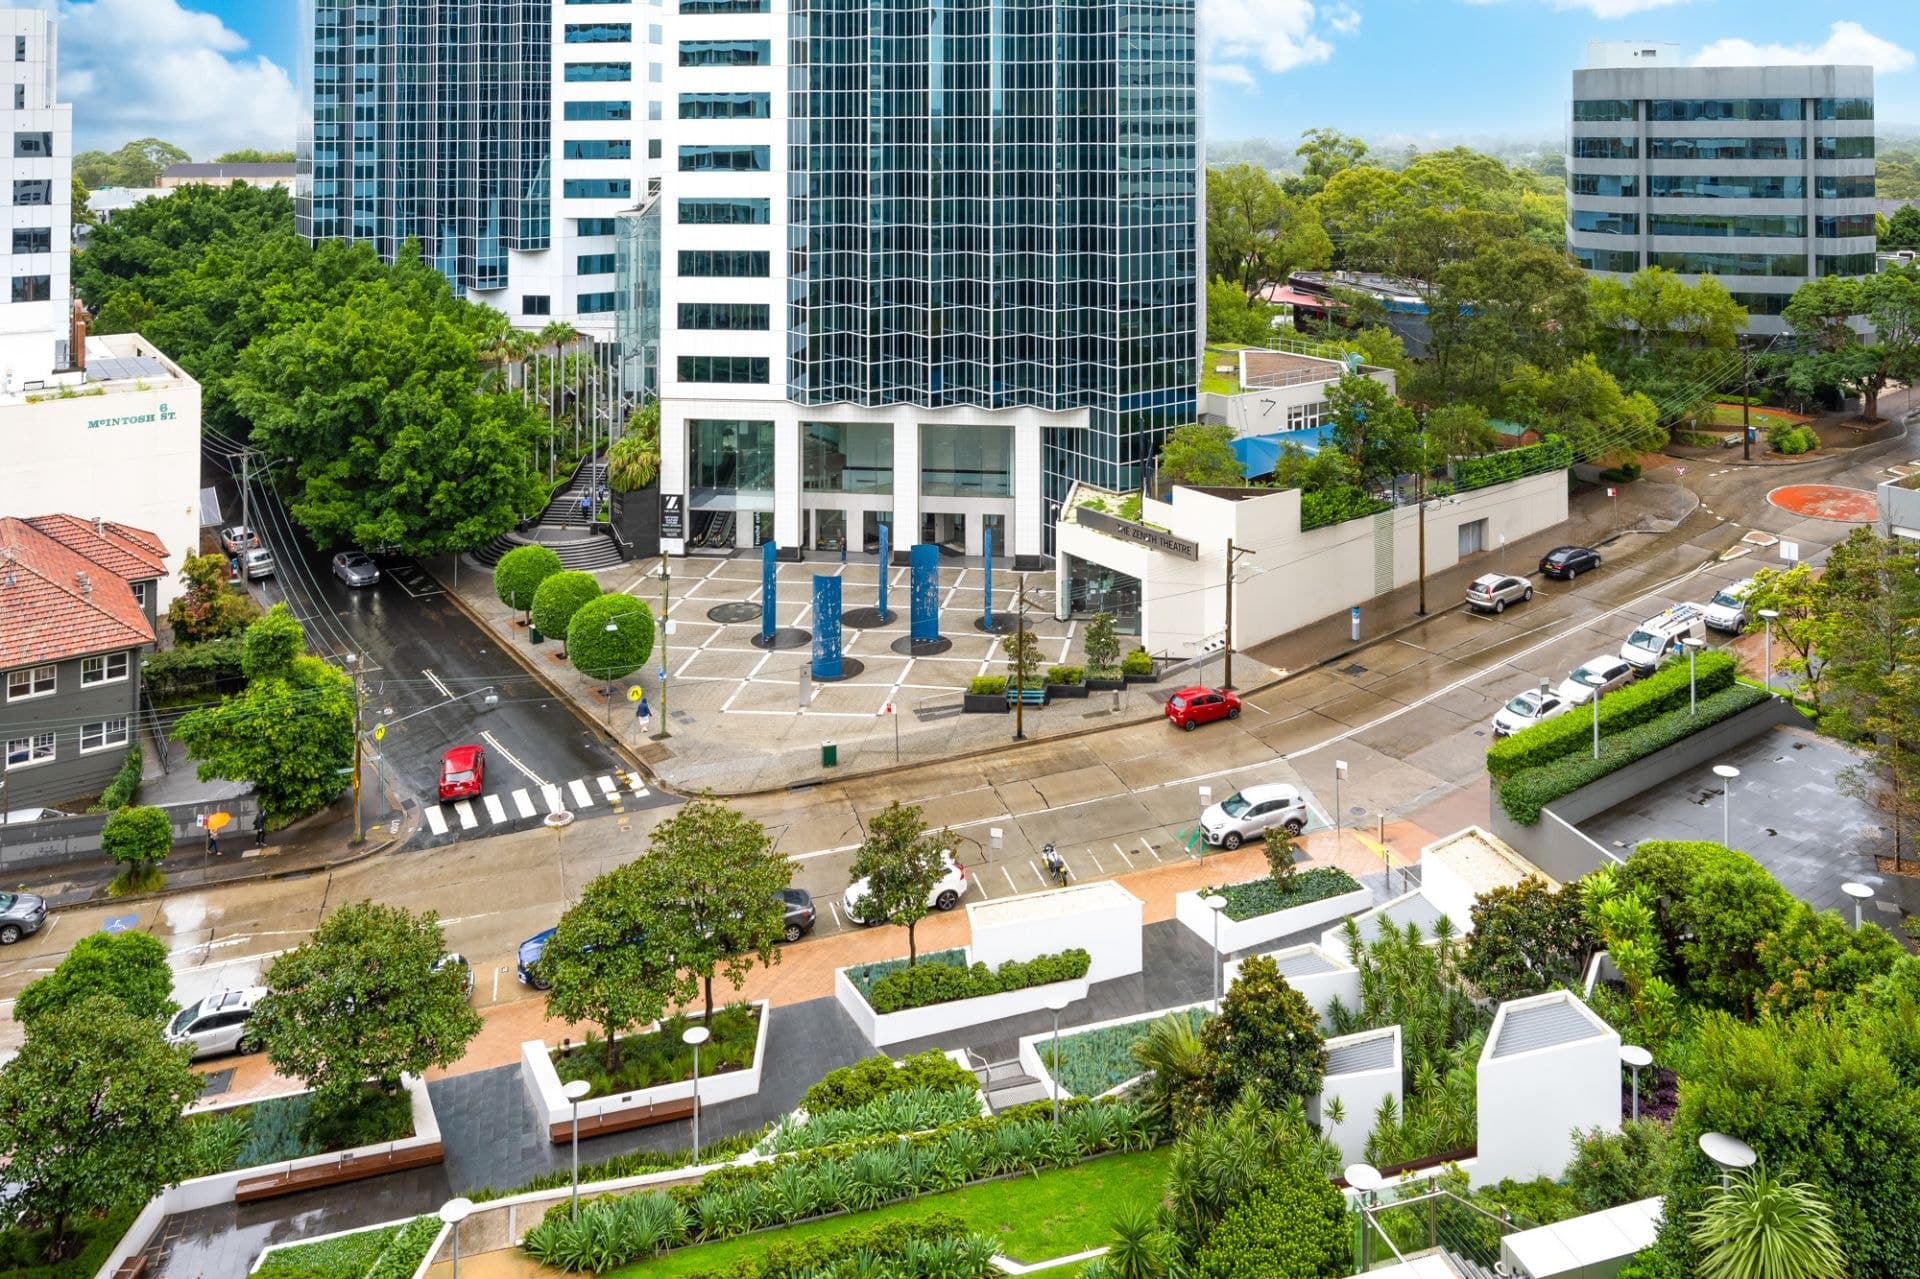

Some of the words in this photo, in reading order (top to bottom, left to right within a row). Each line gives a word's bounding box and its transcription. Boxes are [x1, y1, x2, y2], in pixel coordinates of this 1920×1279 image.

[1116, 524, 1130, 537] THE
[1132, 529, 1157, 544] ZENITH
[1159, 537, 1192, 555] THEATRE
